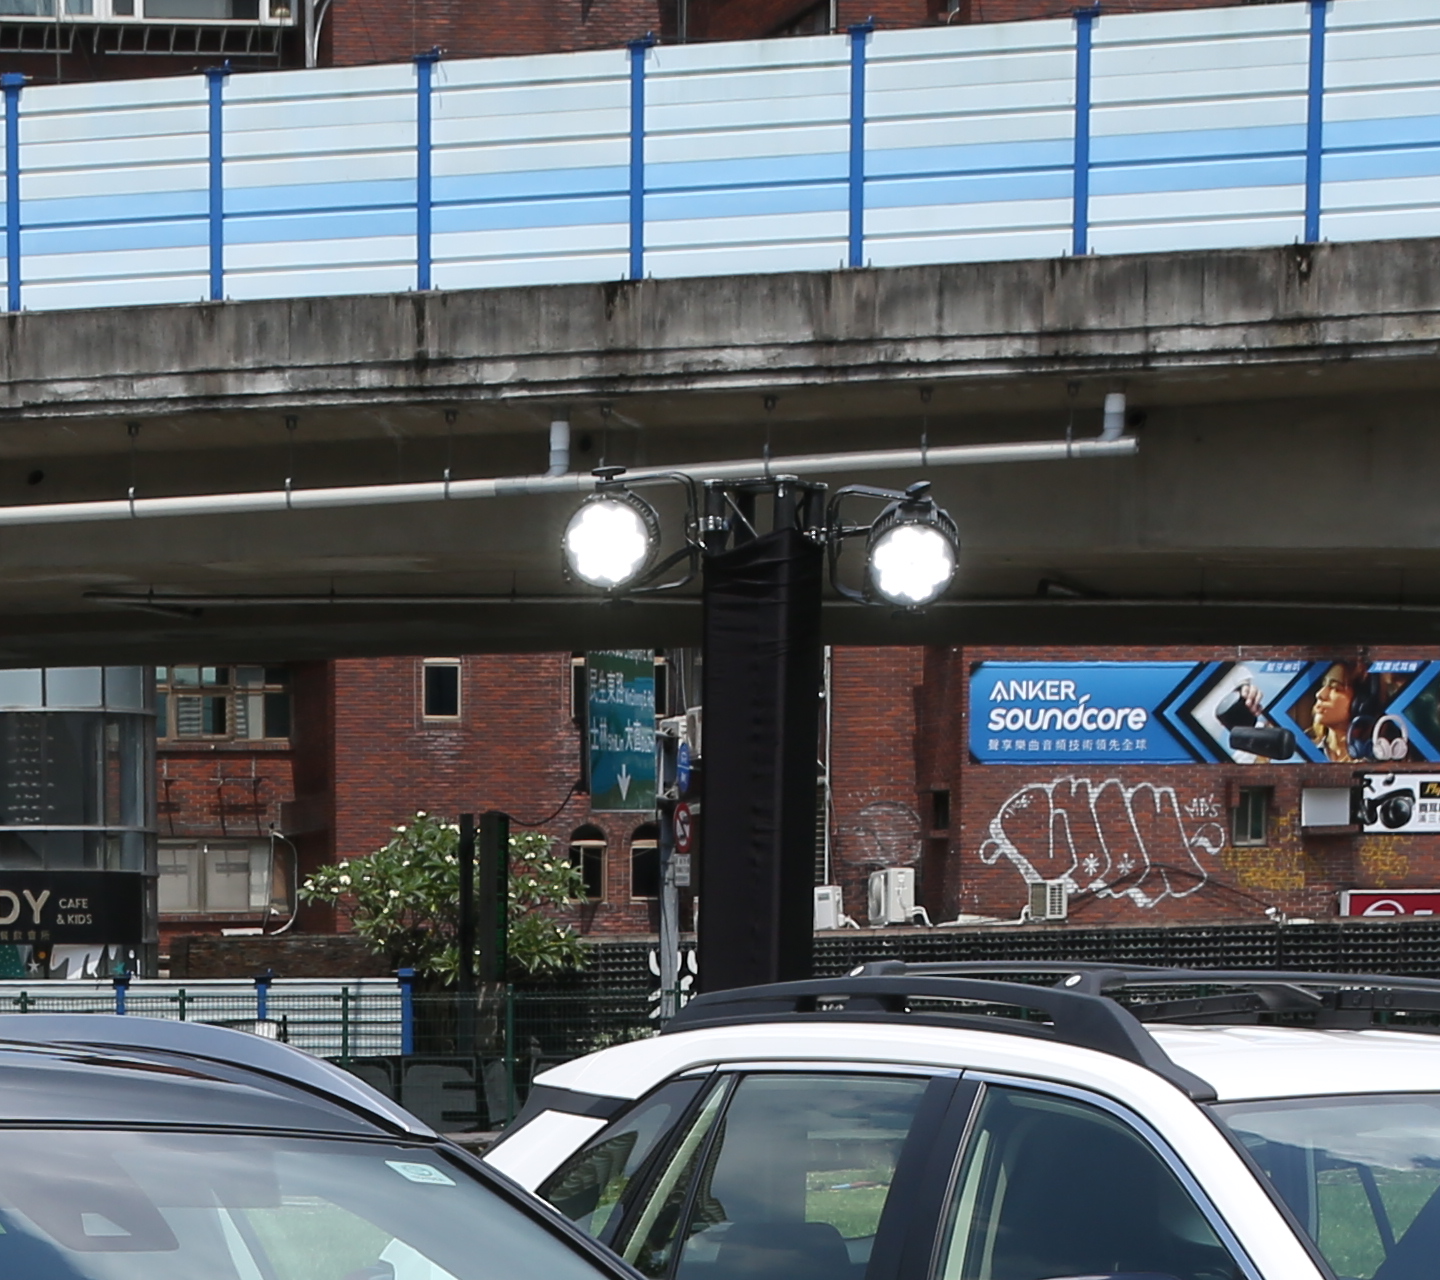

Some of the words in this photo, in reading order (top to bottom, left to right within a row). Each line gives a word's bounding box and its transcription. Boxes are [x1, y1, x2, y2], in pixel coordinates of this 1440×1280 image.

[988, 680, 1077, 703] ANKER
[987, 694, 1148, 732] soundcore
[58, 898, 89, 909] CAFE
[56, 914, 66, 925] &
[67, 914, 93, 925] KIDS
